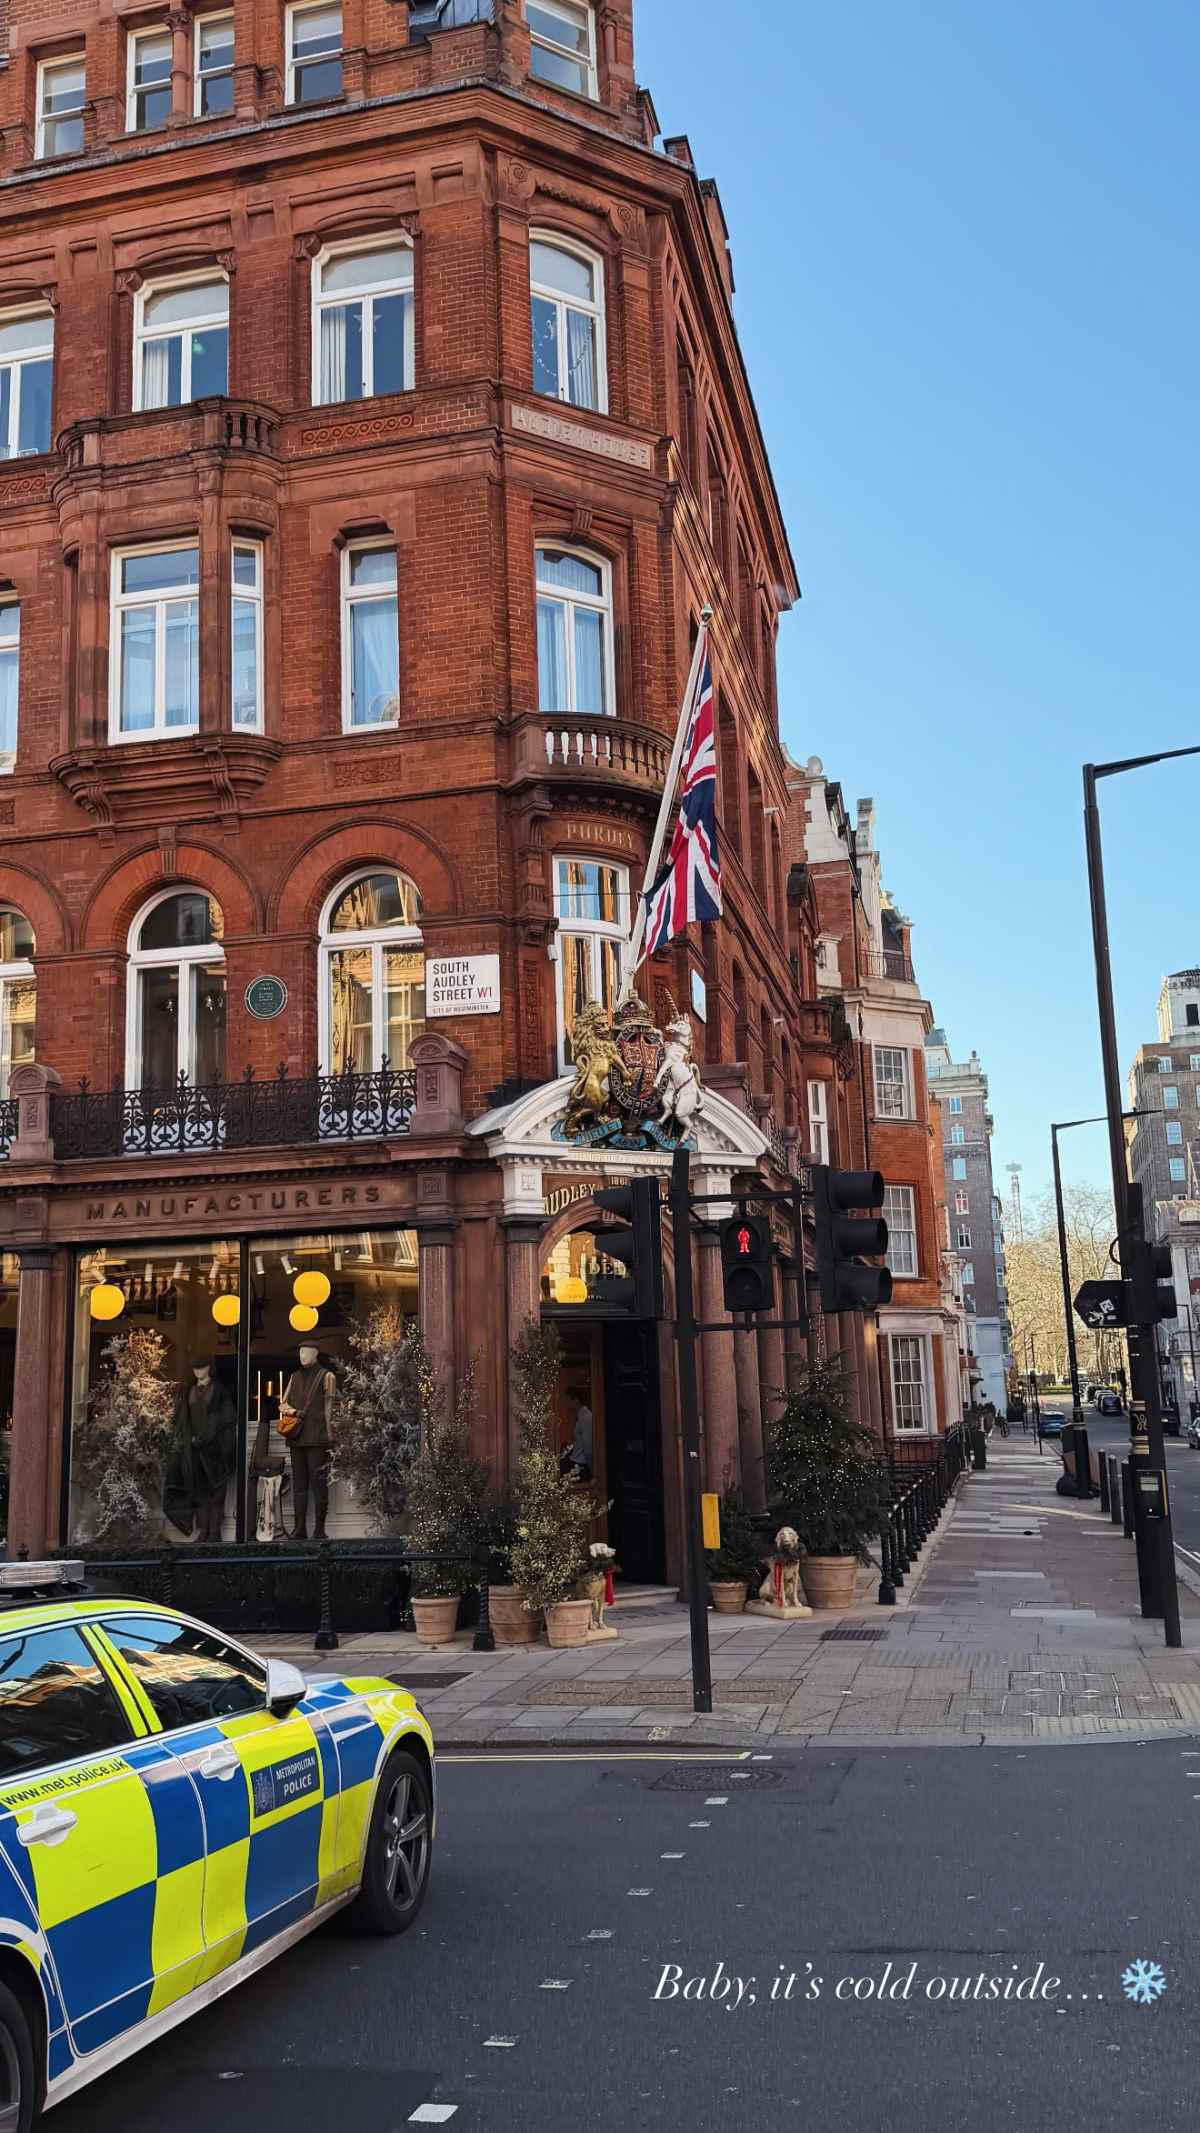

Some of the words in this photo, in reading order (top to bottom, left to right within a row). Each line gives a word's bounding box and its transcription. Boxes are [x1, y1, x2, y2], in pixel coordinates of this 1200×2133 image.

[567, 822, 633, 849] PURDEY
[433, 961, 469, 975] SOUTH
[433, 974, 475, 988] AUDLEY
[433, 987, 473, 1002] STREET
[477, 986, 492, 999] W1
[86, 1186, 381, 1220] MANUFACTURERS
[276, 1756, 316, 1781] METROPOLITAN
[1, 1758, 129, 1806] www.met.police.uk
[283, 1773, 312, 1798] POLICE
